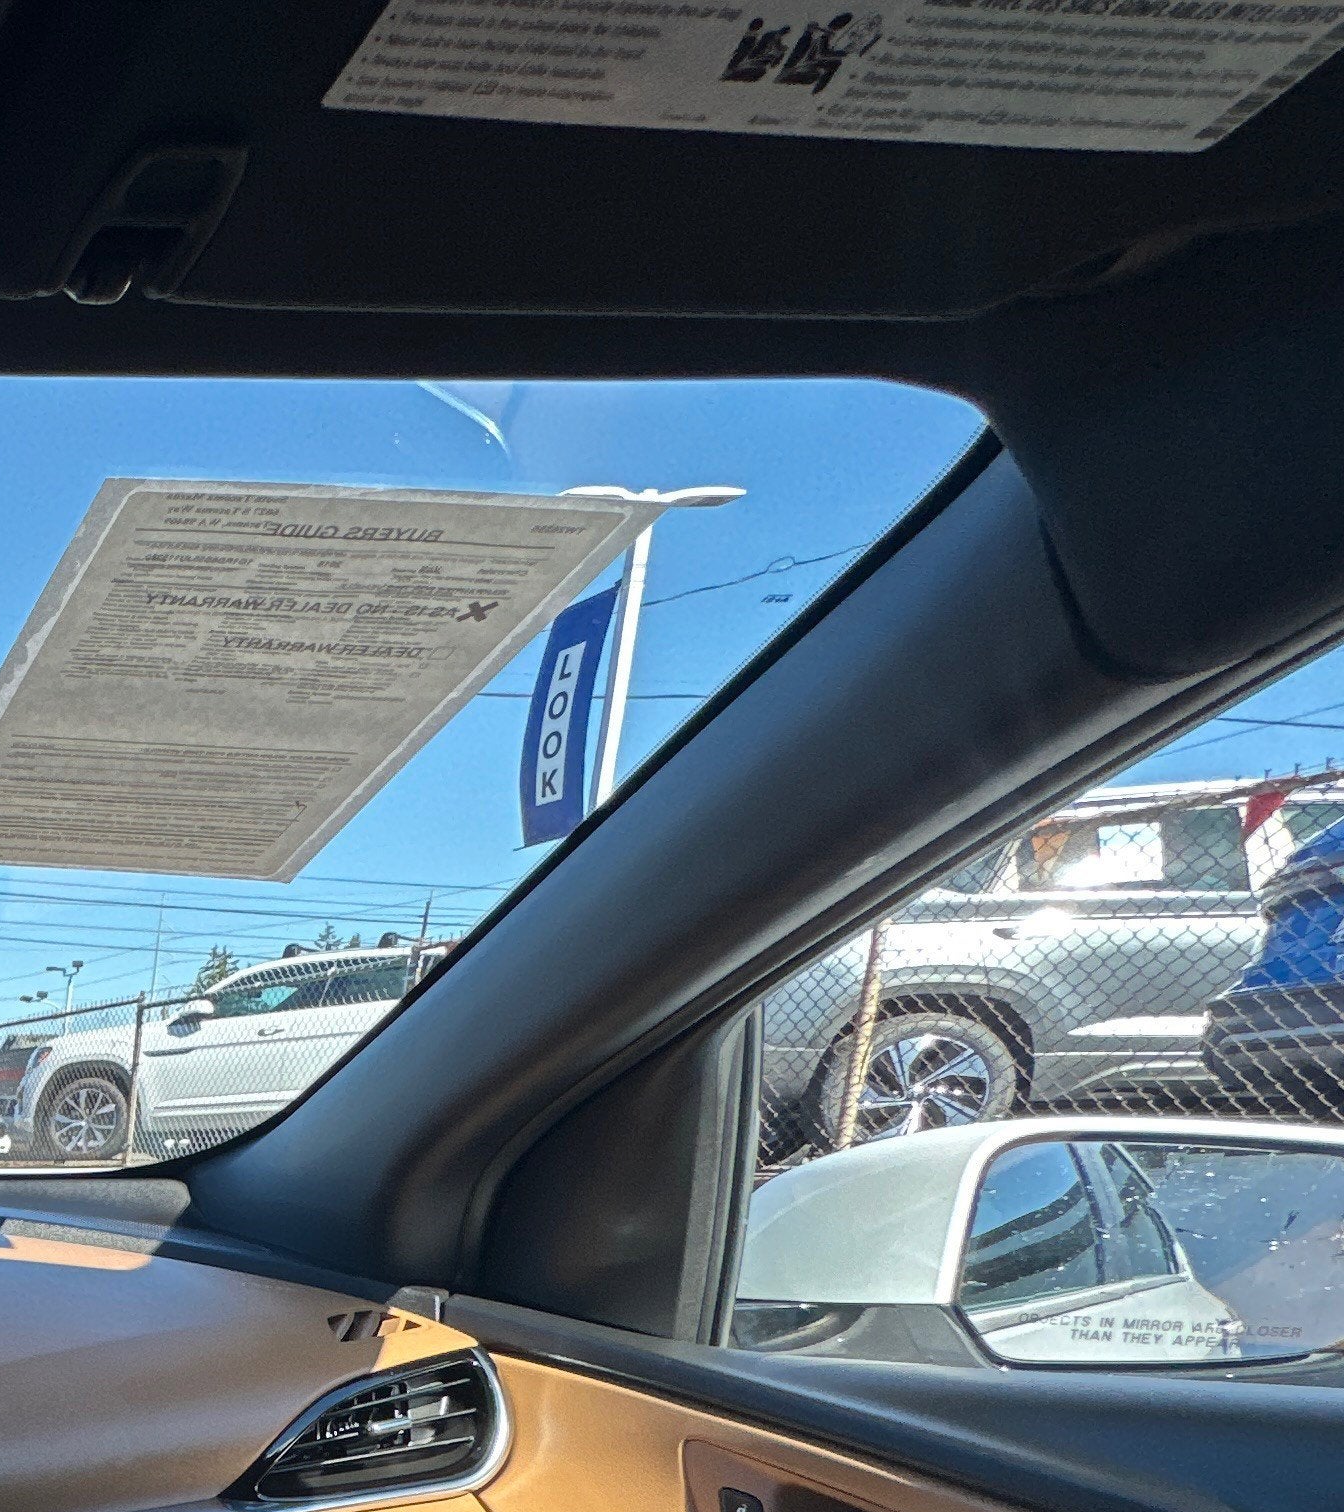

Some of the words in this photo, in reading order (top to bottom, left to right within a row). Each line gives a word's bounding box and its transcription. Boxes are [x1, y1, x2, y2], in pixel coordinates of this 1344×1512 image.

[540, 653, 572, 798] LOOK
[1018, 1312, 1092, 1328] OBJECTS
[1099, 1317, 1115, 1329] IN
[1122, 1319, 1184, 1333] MIRROR
[1235, 1323, 1303, 1339] CLOSER
[1070, 1329, 1113, 1343] THAN
[1122, 1331, 1163, 1346] THEY
[1171, 1335, 1241, 1350] APPEAR
